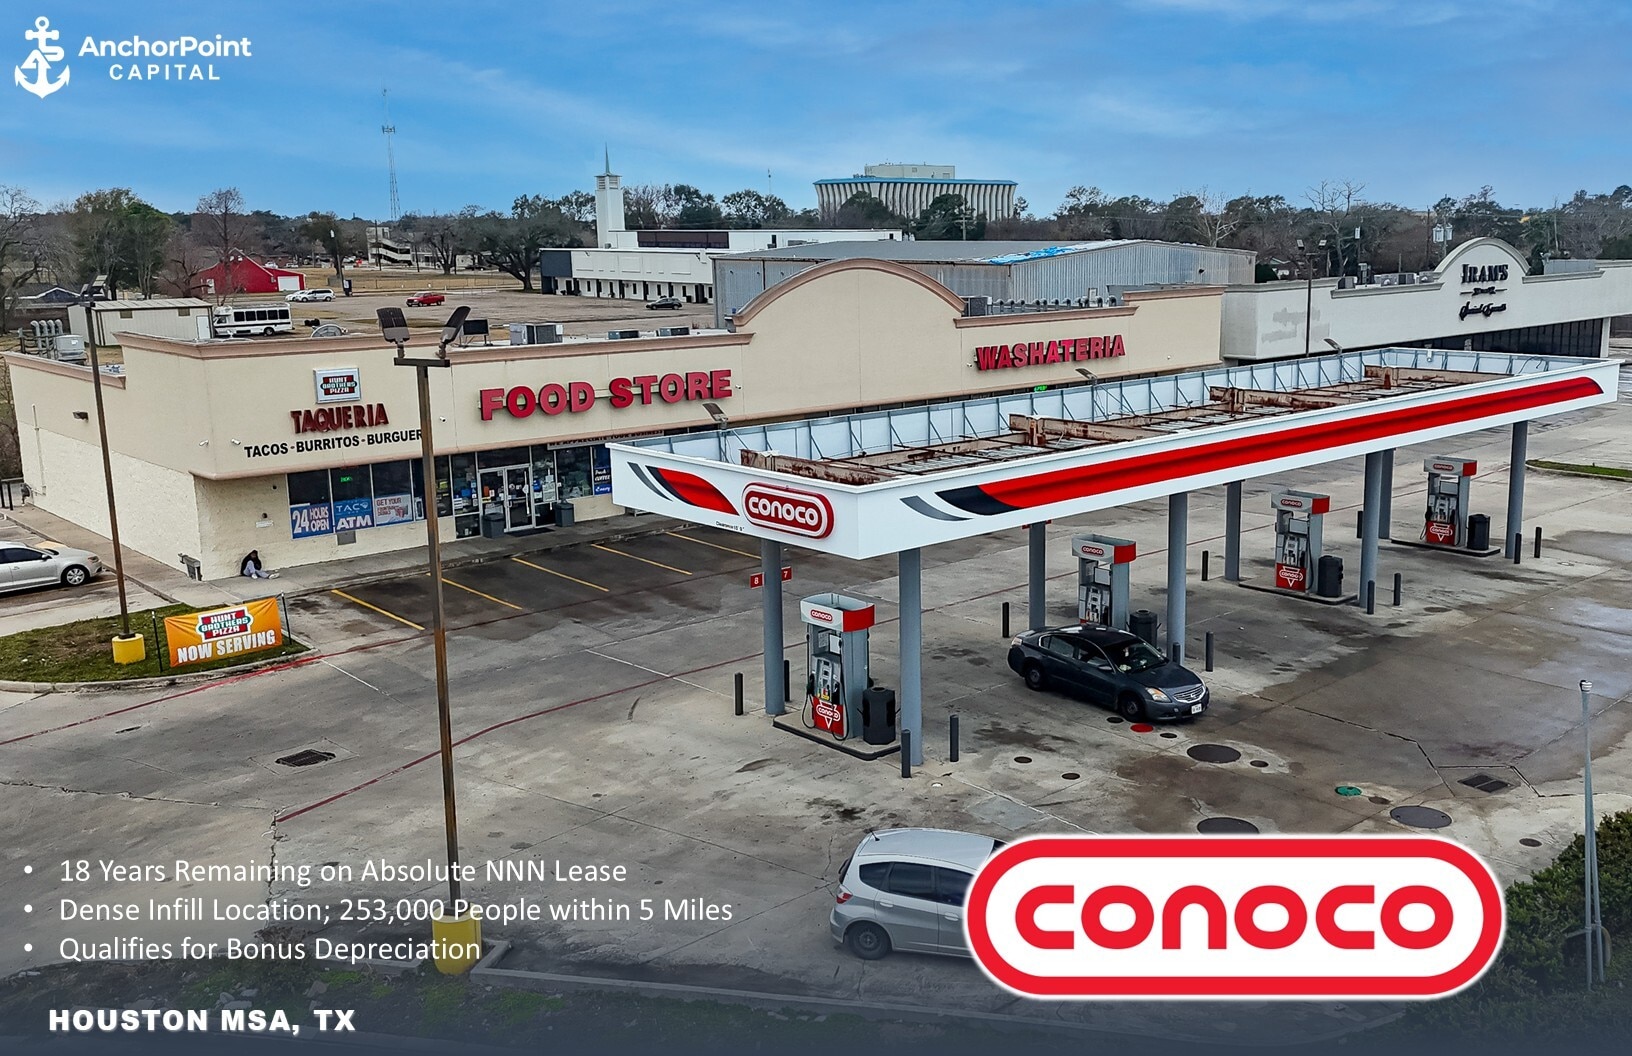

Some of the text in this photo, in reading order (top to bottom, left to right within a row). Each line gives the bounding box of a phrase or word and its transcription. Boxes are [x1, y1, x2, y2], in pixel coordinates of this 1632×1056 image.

[975, 334, 1126, 371] WASHATERIA
[322, 381, 356, 389] BROTHERS
[480, 369, 733, 421] FOOD STORE
[290, 403, 389, 433] TAQUERIA
[244, 442, 288, 458] TACOS
[296, 435, 360, 453] BURRITOS
[388, 497, 402, 505] YOUR
[309, 506, 329, 520] HOURS
[292, 508, 309, 534] 24
[310, 518, 330, 532] OPEN
[336, 515, 372, 530] ATM
[754, 576, 759, 584] 8
[201, 617, 249, 632] BROTHERS
[210, 612, 237, 624] HUNT
[212, 626, 240, 637] PIZZA
[177, 630, 276, 664] NOW SERVING
